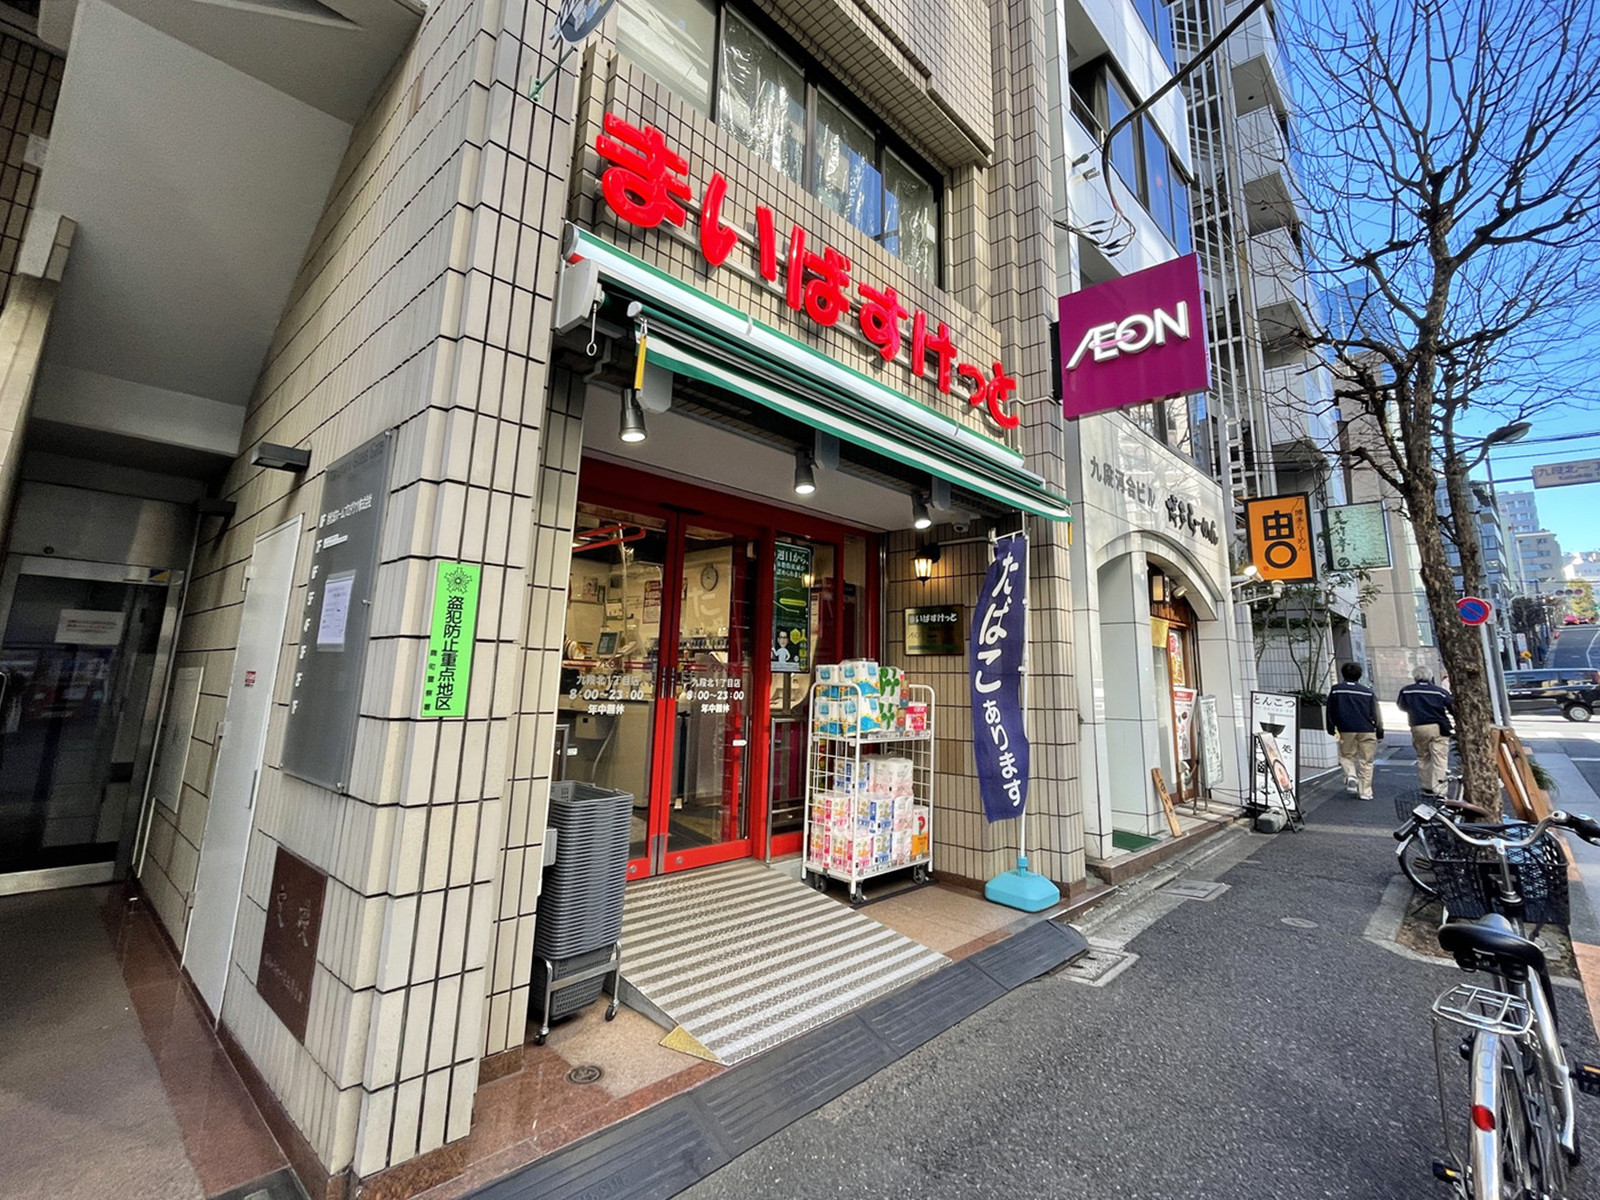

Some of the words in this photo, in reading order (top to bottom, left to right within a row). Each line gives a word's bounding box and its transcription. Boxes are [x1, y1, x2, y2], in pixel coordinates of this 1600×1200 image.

[595, 111, 1020, 429] まいばすけっと
[1090, 456, 1156, 509] 九段河合ビル
[435, 595, 464, 710] 盗犯防止重点地区
